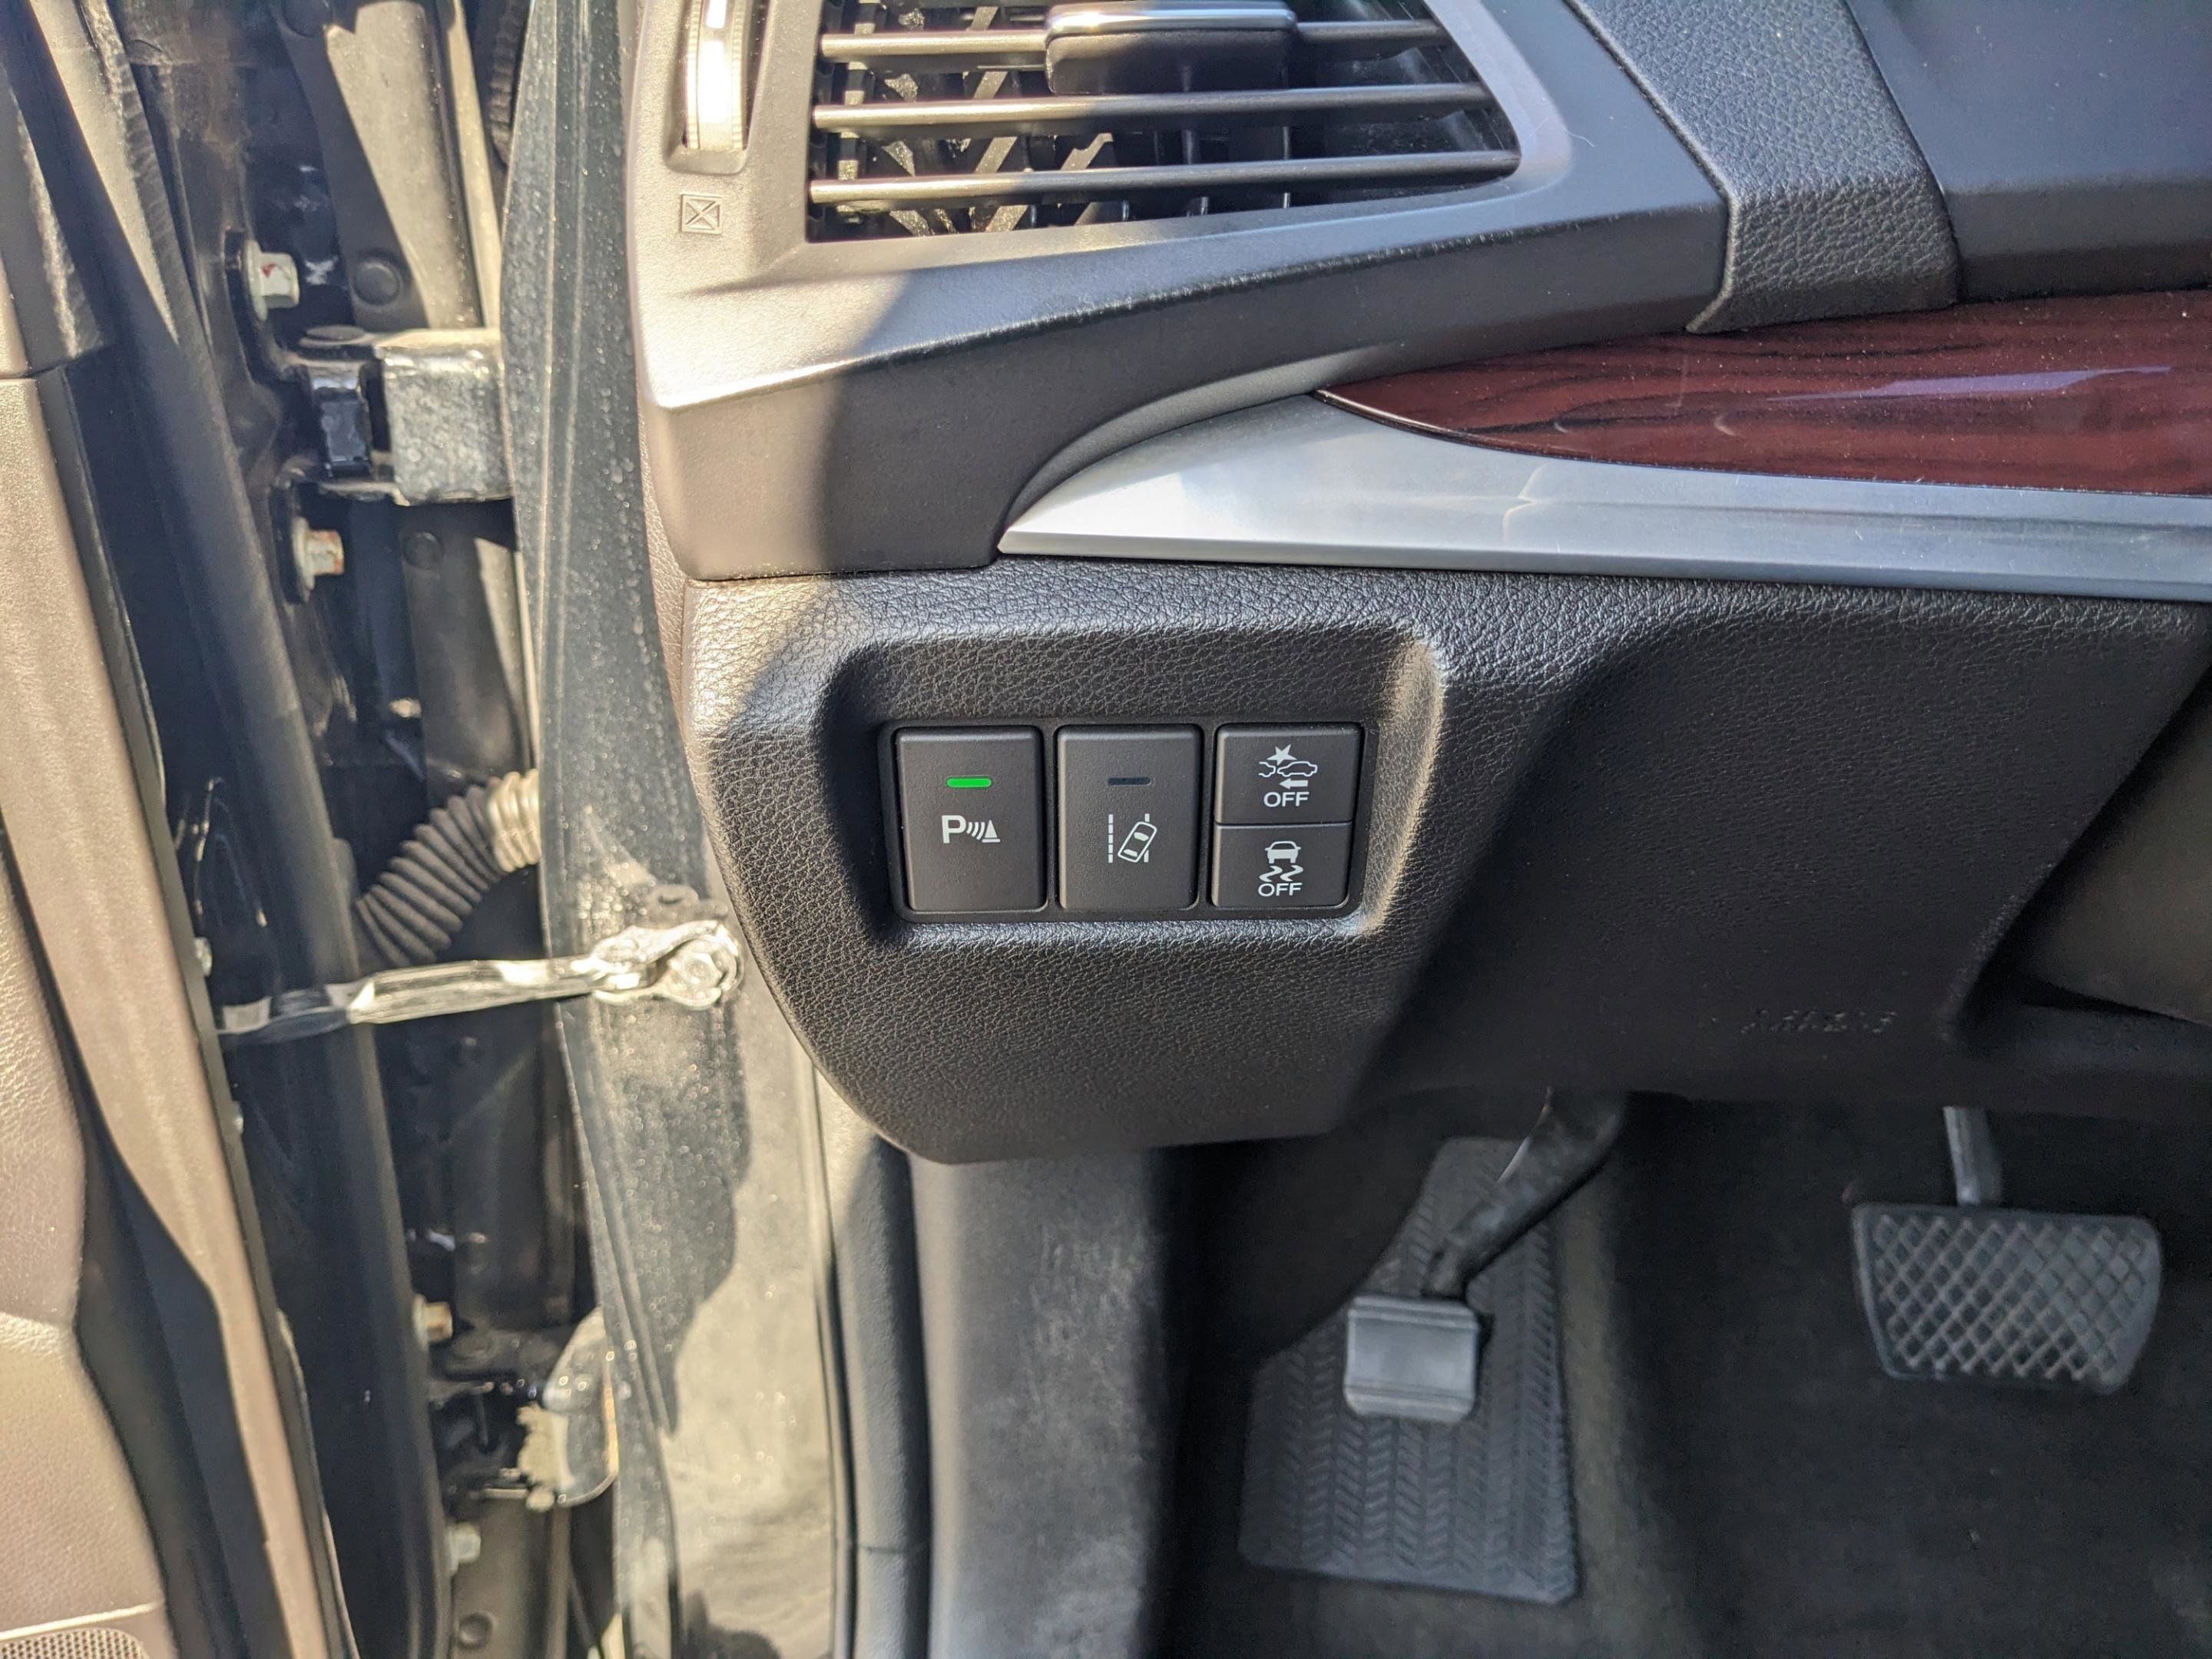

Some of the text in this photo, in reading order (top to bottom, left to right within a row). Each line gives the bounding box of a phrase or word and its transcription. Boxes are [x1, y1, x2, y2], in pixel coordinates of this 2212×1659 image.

[1263, 791, 1310, 807] OFF
[942, 815, 967, 844] P
[1258, 882, 1303, 897] OFF
